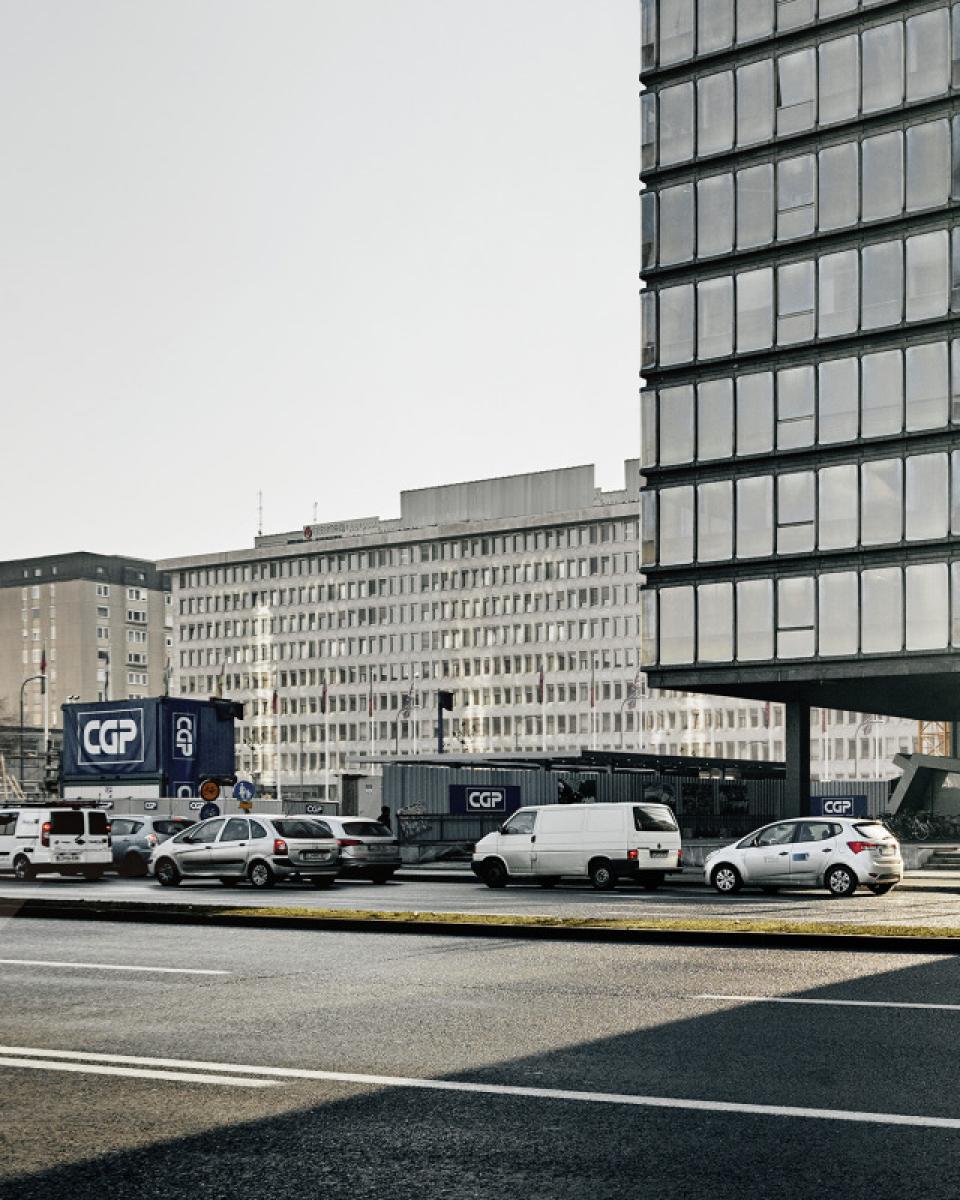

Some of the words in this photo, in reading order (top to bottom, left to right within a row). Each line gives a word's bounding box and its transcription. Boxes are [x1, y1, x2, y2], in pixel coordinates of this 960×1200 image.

[83, 719, 138, 755] CGP
[176, 716, 193, 757] CGP
[469, 791, 502, 808] CGP
[824, 800, 852, 814] CGP
